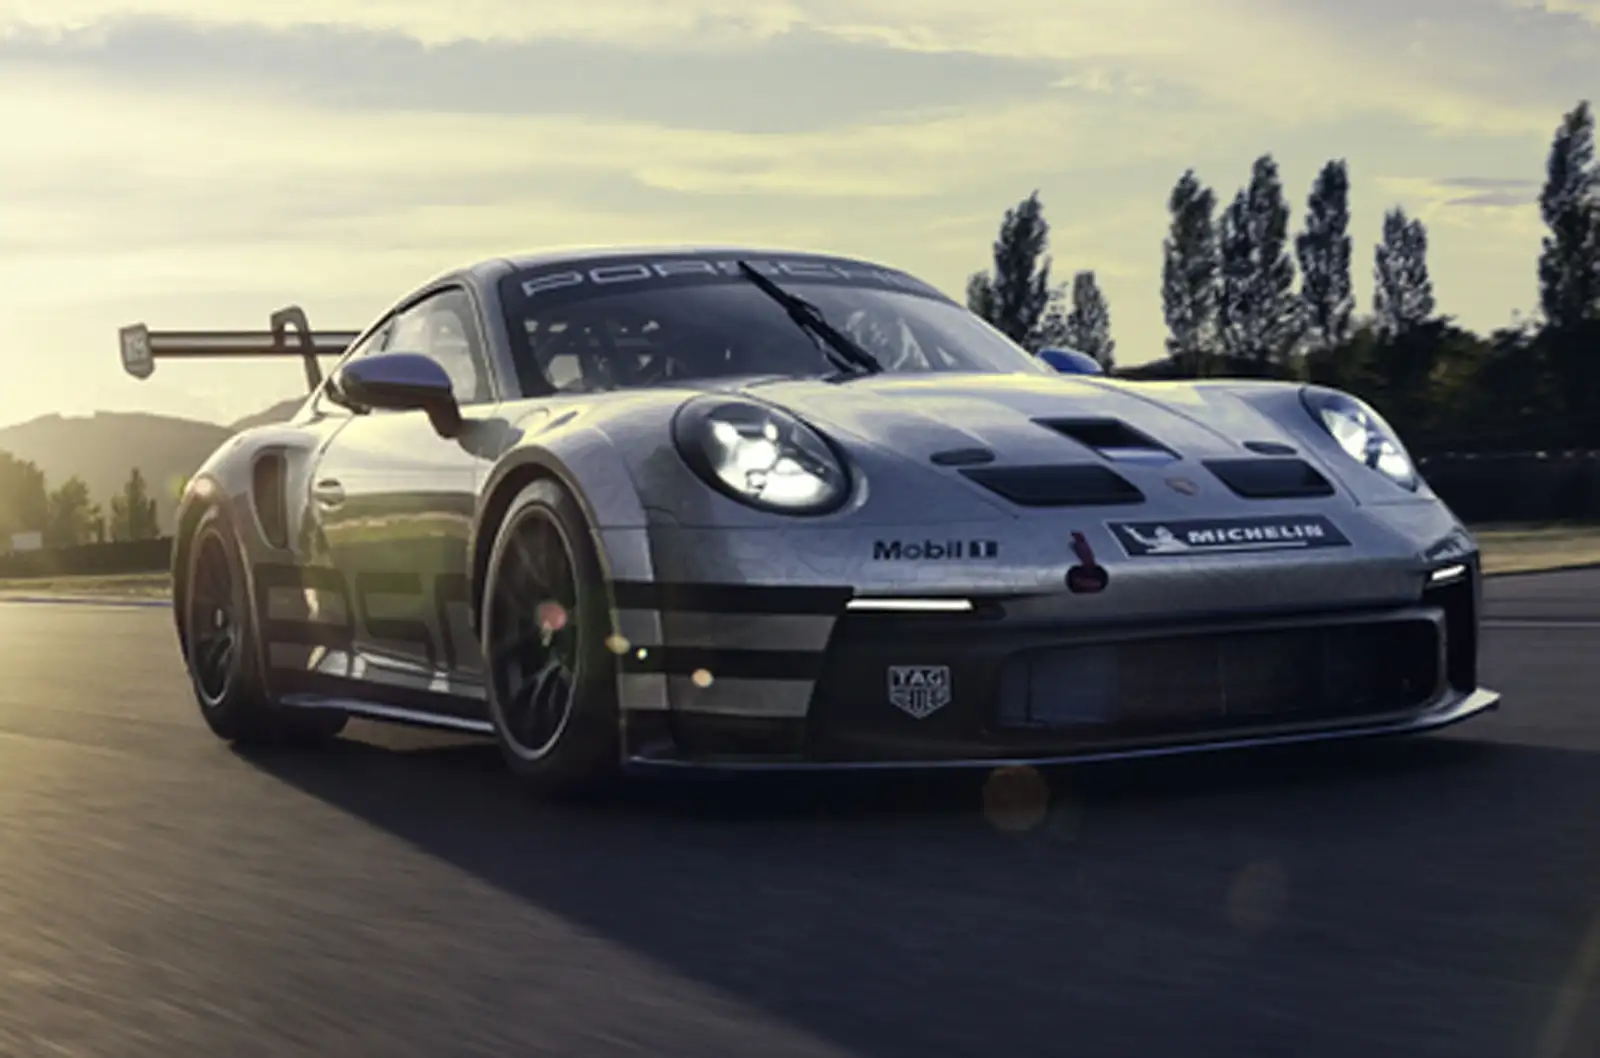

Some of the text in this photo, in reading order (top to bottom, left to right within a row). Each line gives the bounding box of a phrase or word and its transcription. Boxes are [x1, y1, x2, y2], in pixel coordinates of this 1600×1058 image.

[1187, 524, 1325, 544] MICHELIN
[873, 540, 962, 560] Mobil
[894, 669, 943, 685] TAG
